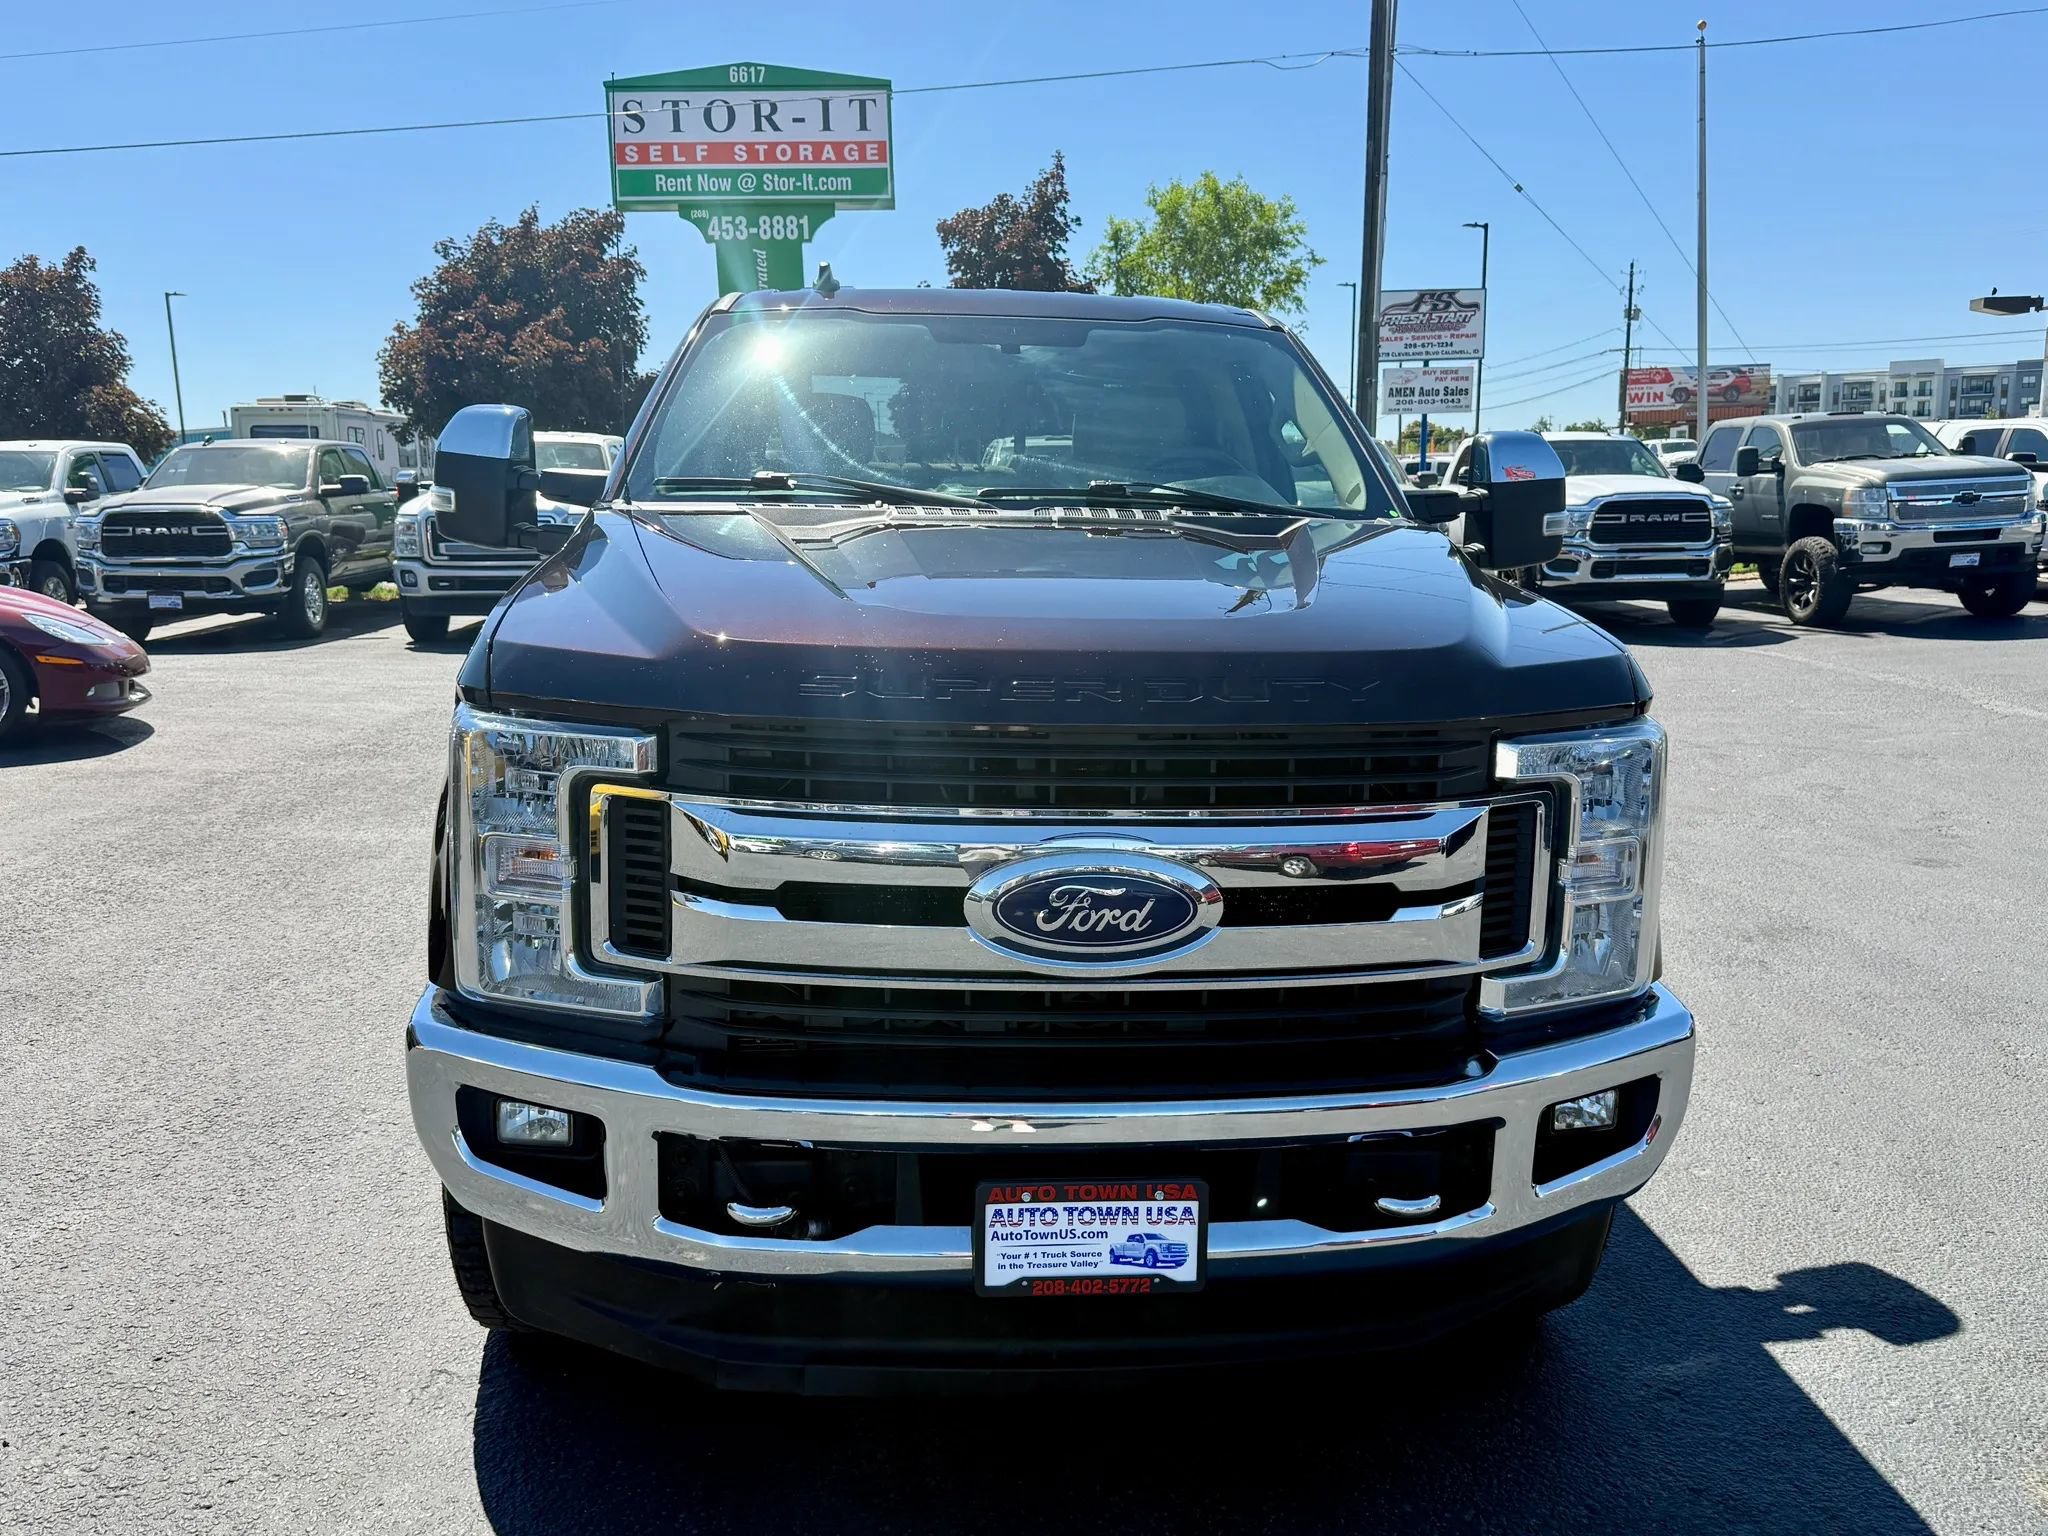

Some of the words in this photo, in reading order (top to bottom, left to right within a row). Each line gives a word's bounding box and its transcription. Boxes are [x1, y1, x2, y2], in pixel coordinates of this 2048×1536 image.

[729, 66, 765, 83] 6617
[622, 99, 877, 134] STOR-IT
[624, 145, 708, 162] SELF
[734, 144, 879, 161] STORAGE
[655, 174, 692, 192] Rent
[697, 174, 732, 191] Now
[737, 173, 756, 193] @
[763, 174, 852, 191] Stor-It.com
[707, 215, 810, 240] 453-8881
[753, 248, 768, 289] rated
[1388, 387, 1416, 398] AMEN
[1418, 386, 1440, 397] Auto
[1443, 386, 1469, 396] Sales
[1629, 392, 1664, 403] WIN
[1630, 514, 1679, 522] RAM
[797, 676, 1122, 702] SUPER
[1142, 677, 1381, 702] DUTY
[1036, 885, 1155, 931] Ford
[987, 1185, 1056, 1202] AUTO
[1064, 1184, 1137, 1201] TOWN
[1146, 1184, 1198, 1200] USA
[989, 1207, 1059, 1228] AUTO
[1063, 1206, 1139, 1226] TOWN
[1146, 1206, 1196, 1226] USA
[991, 1229, 1108, 1241] AutoTownUS.com
[1041, 1251, 1067, 1259] Truck
[1070, 1250, 1102, 1258] Source
[998, 1262, 1006, 1270] in
[1009, 1262, 1024, 1270] the
[1027, 1261, 1067, 1269] Treasure
[1032, 1278, 1150, 1295] 208-402-5772
